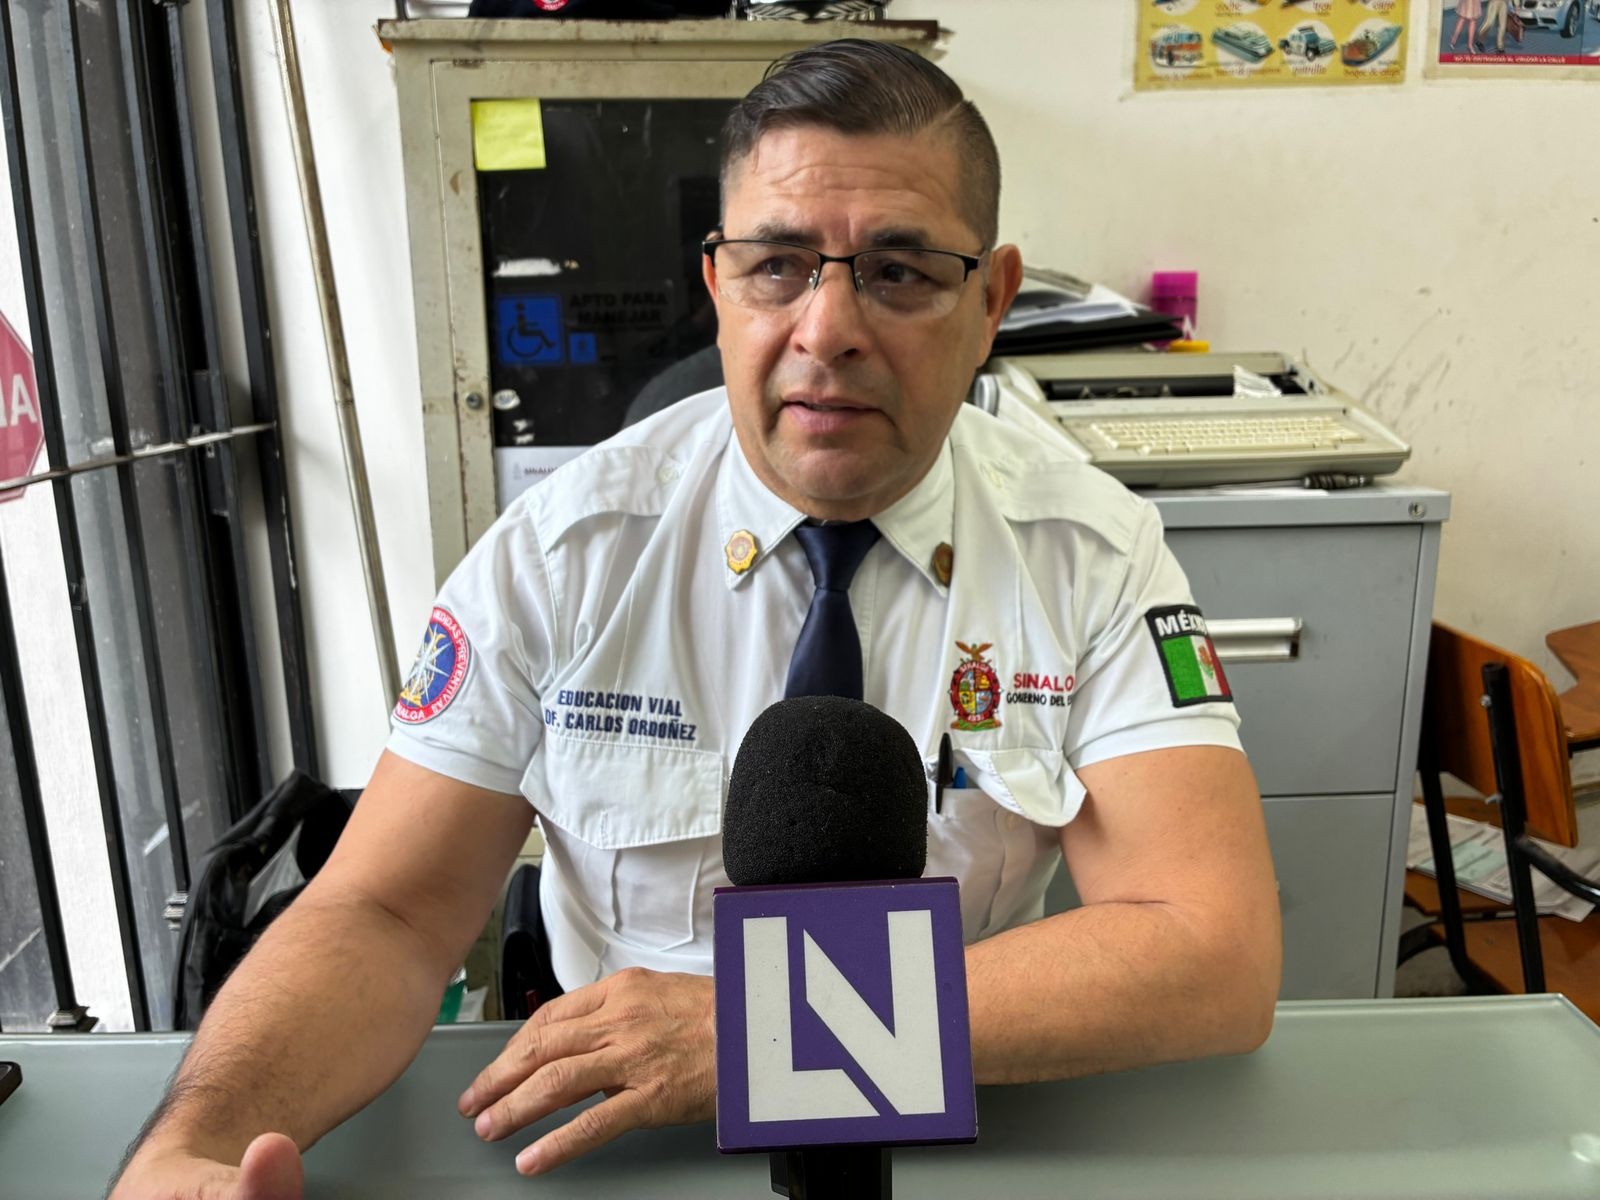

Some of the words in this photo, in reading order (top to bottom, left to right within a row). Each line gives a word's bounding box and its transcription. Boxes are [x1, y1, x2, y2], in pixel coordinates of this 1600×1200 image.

[570, 293, 618, 307] APTO
[623, 291, 669, 306] PARA
[577, 309, 662, 324] MANEJAR
[1013, 672, 1075, 692] SINALO
[557, 689, 643, 712] EDUCACION
[648, 696, 683, 717] VIAL
[1050, 694, 1065, 707] DEL
[565, 712, 624, 733] CARLOS
[628, 717, 697, 741] ORDOÑEZ
[743, 909, 946, 1123] LN
